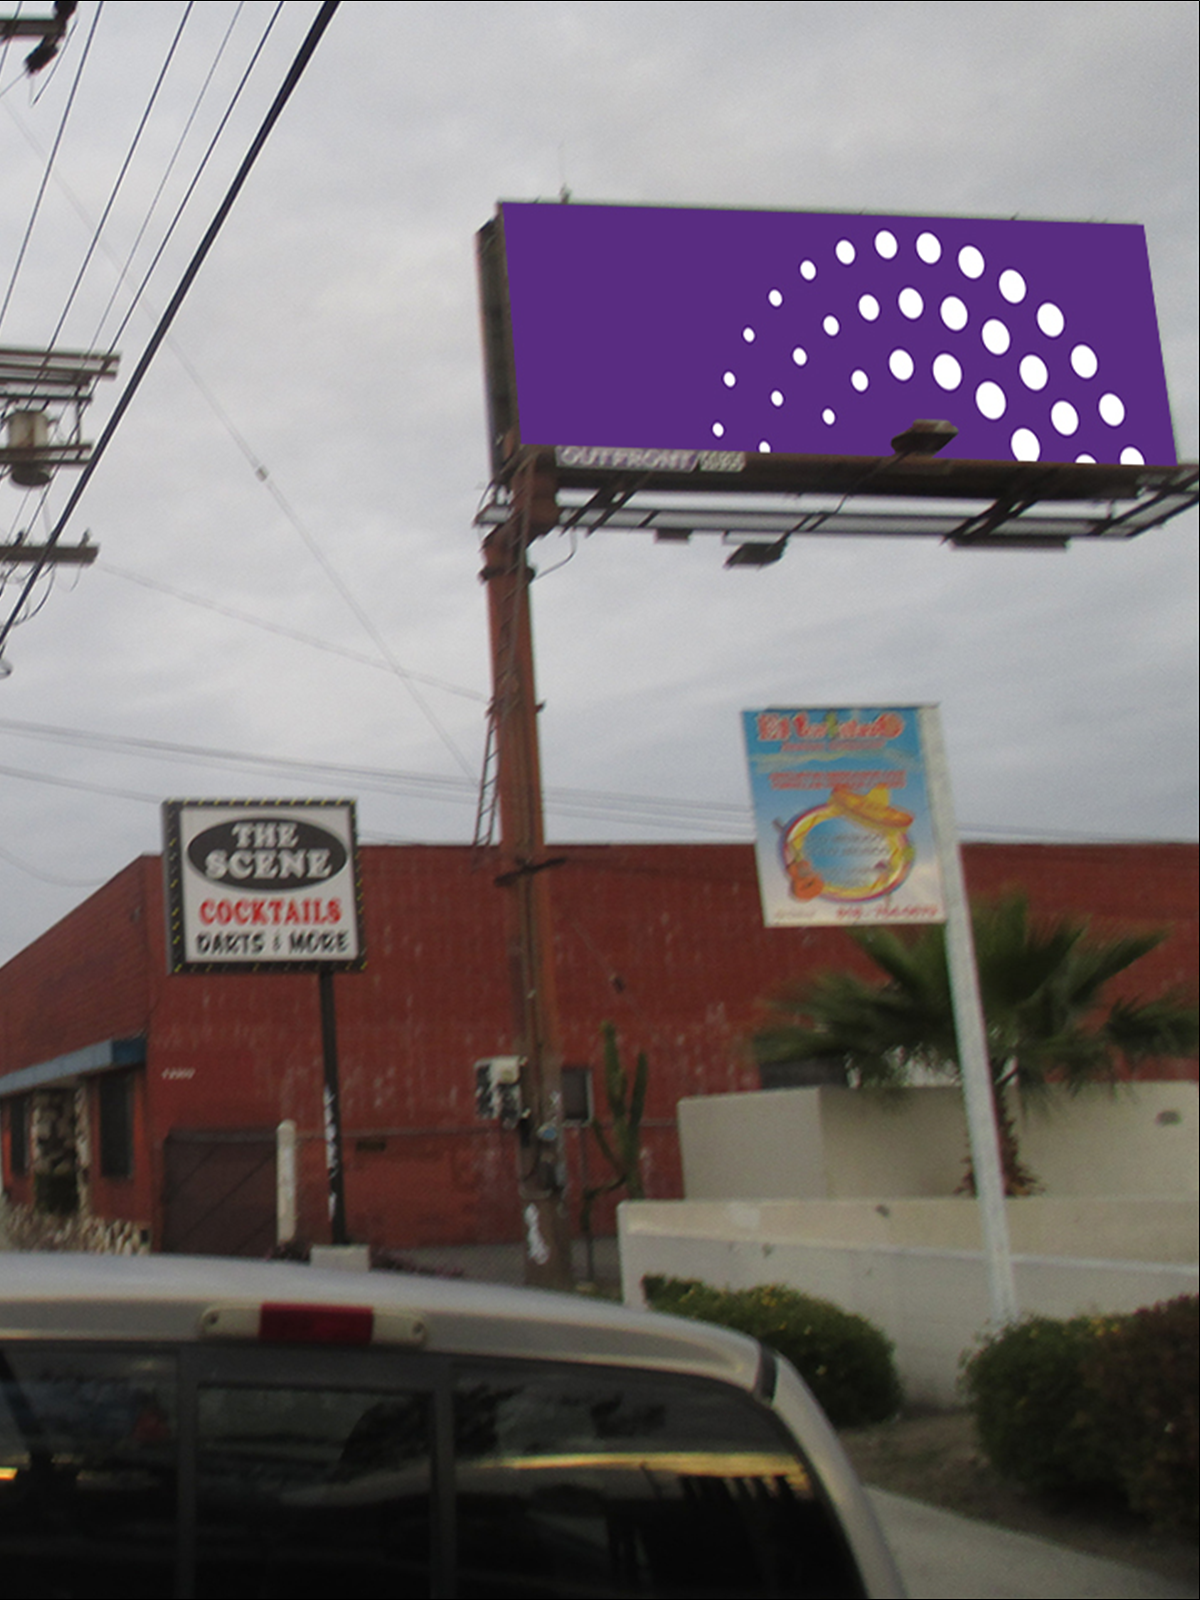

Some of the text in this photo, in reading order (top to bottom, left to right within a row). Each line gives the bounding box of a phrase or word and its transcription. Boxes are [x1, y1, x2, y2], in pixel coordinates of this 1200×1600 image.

[561, 446, 695, 472] OUTFRONT
[232, 822, 299, 848] THE
[204, 848, 333, 879] SCENE
[198, 898, 342, 926] COCKTAILS
[196, 930, 265, 955] DARTS
[288, 930, 351, 953] MORE
